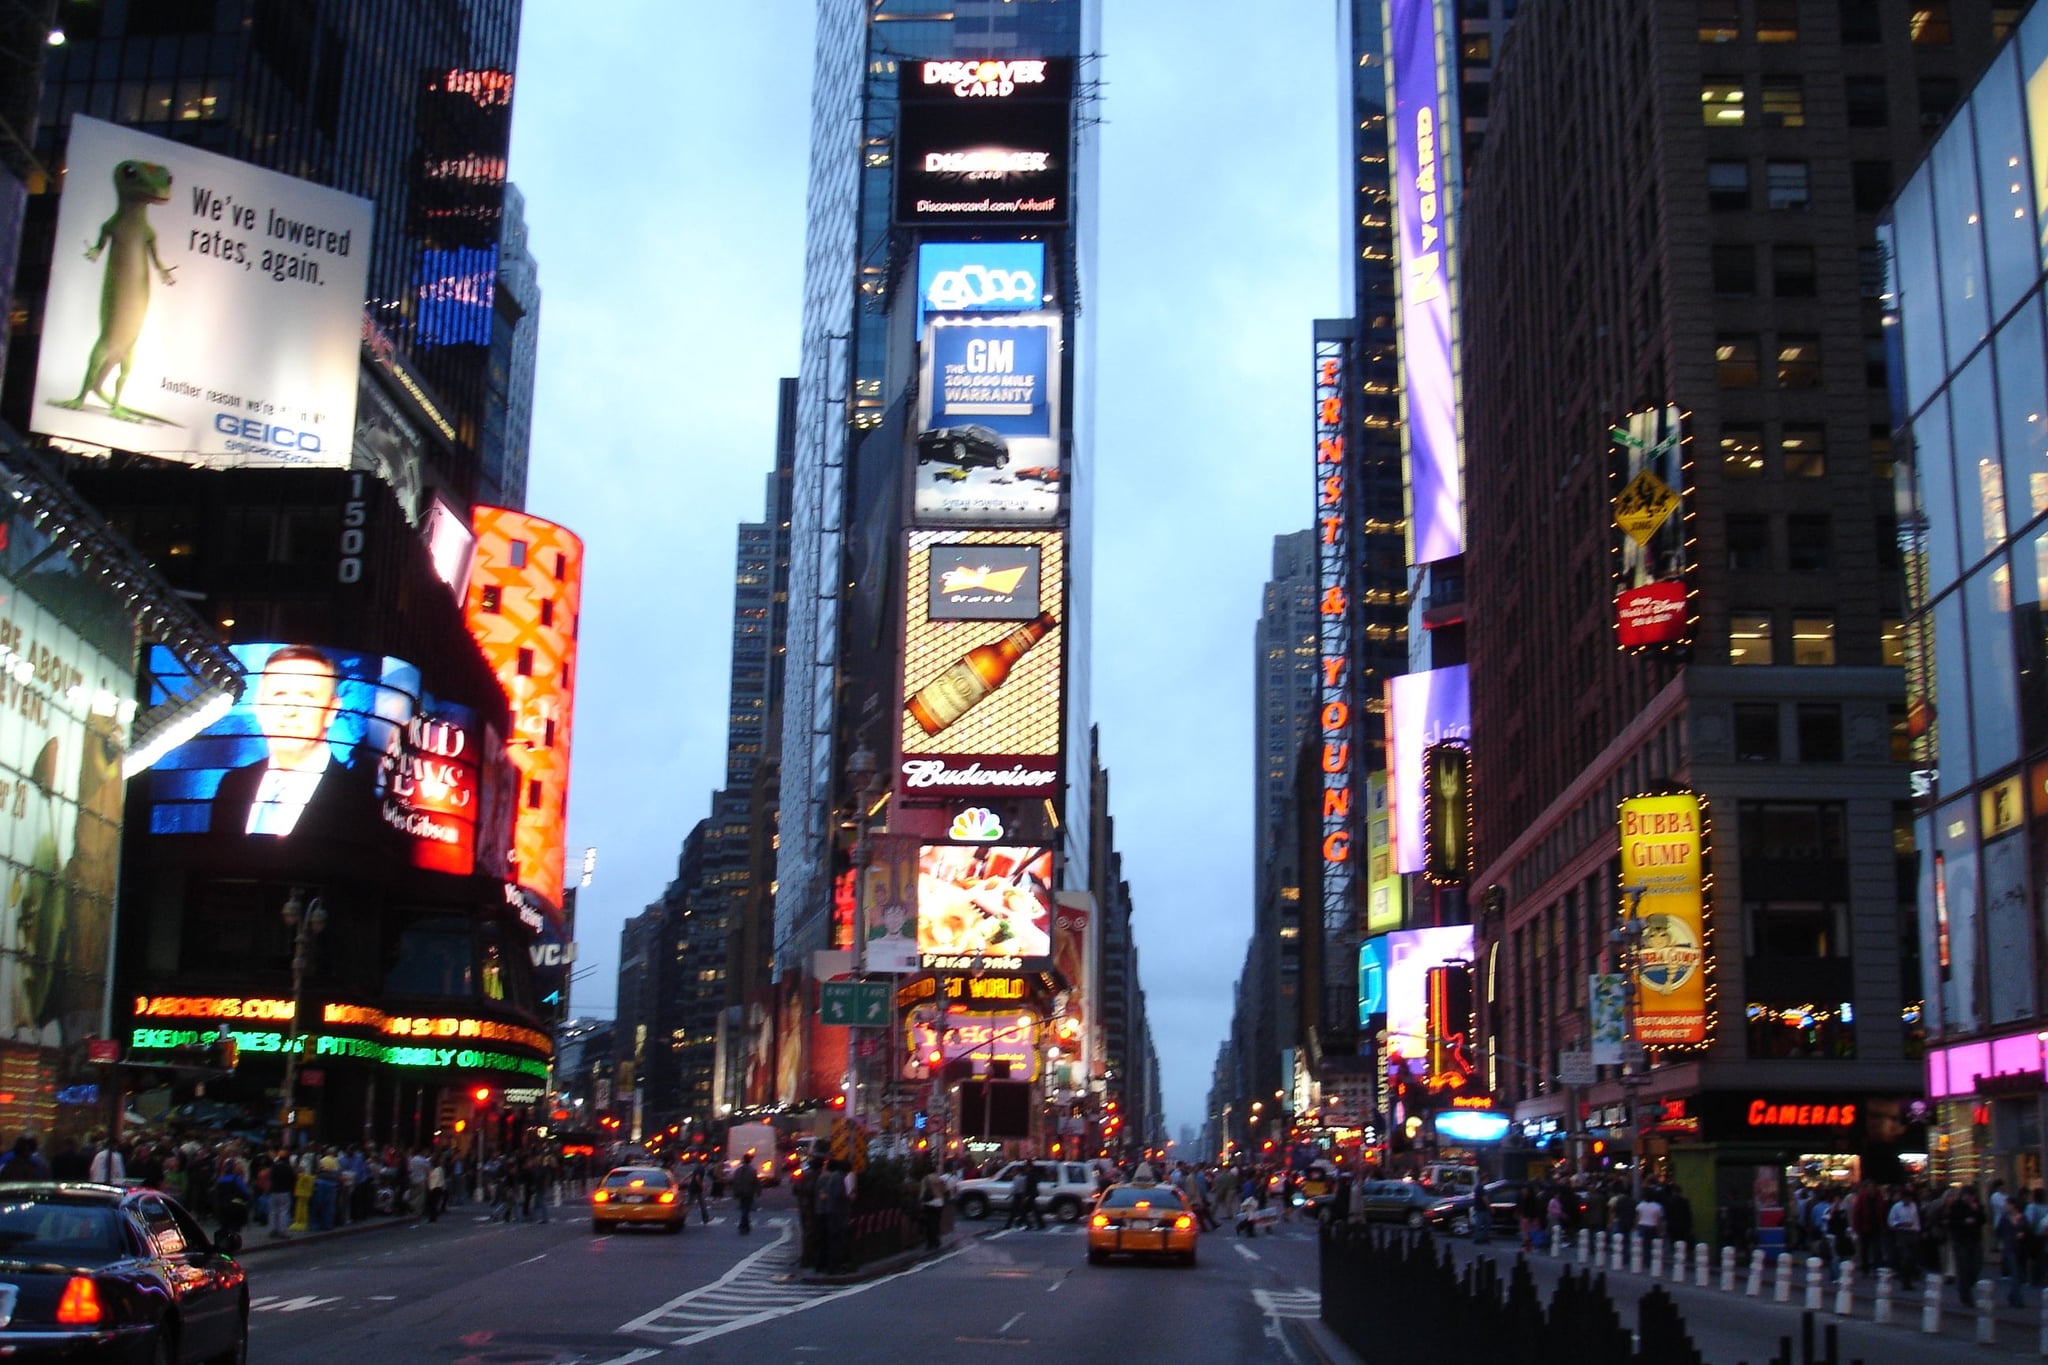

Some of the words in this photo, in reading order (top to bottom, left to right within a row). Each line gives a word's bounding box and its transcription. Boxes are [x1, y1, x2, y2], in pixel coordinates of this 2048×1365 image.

[924, 60, 1047, 84] DISCOVER
[954, 80, 1015, 97] CARD
[926, 152, 1049, 172] DISCOVER
[193, 186, 256, 231] We've
[266, 207, 352, 257] lowered
[189, 228, 252, 271] rates,
[262, 249, 325, 286] again.
[945, 364, 966, 375] THE
[966, 339, 1015, 374] GM
[944, 375, 1002, 388] 100,000
[1002, 375, 1035, 387] MILE
[944, 387, 1034, 402] WARRANTY
[205, 390, 241, 408] reason
[214, 412, 322, 453] GEICO
[1318, 357, 1344, 546] ERNST
[338, 473, 366, 583] 1500
[1320, 587, 1346, 615] &
[1322, 655, 1350, 863] YOUNG
[902, 760, 1056, 787] Budweiser
[1624, 808, 1695, 836] BUBBA
[1631, 840, 1690, 867] GUMP
[923, 954, 1022, 970] Panaonic
[1641, 1028, 1693, 1039] MARKET
[1377, 1046, 1391, 1113] REUTERS
[1748, 1099, 1856, 1125] CAMERAS
